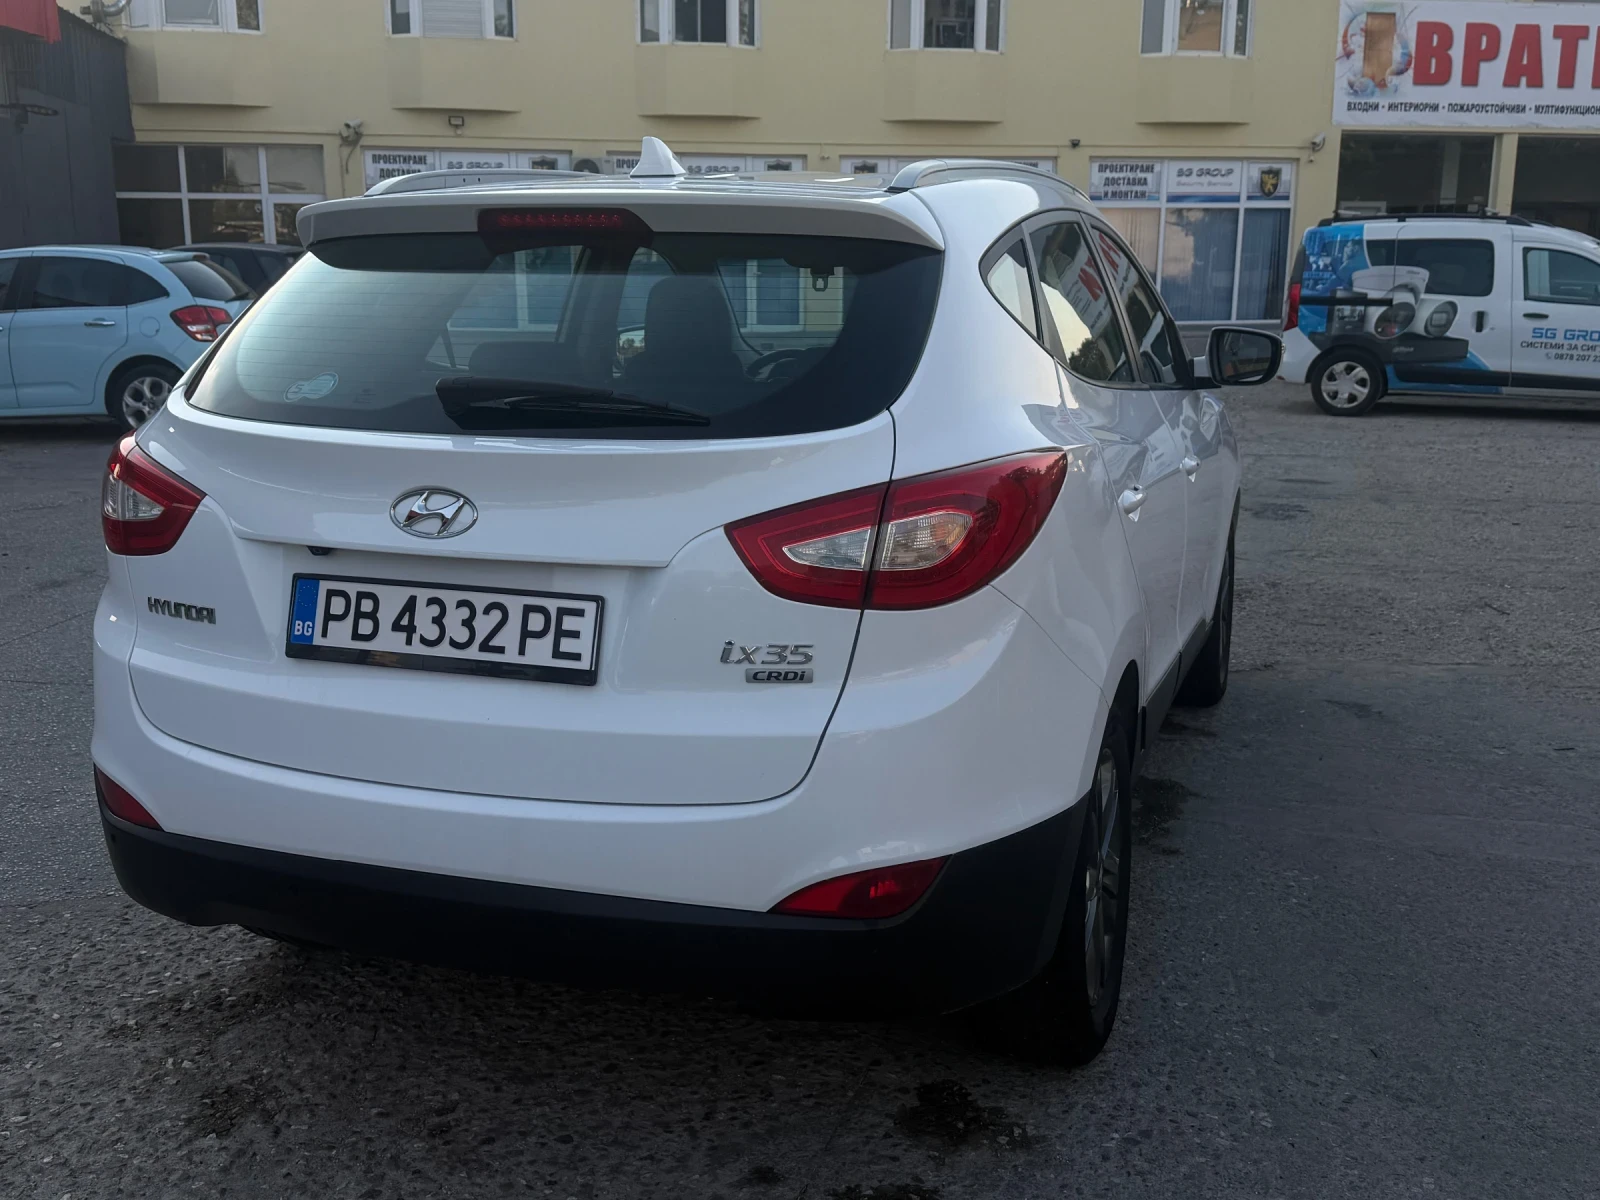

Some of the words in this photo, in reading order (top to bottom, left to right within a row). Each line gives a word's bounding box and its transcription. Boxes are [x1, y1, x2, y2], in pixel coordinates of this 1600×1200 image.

[1413, 21, 1600, 89] ВРАТ
[1346, 101, 1380, 112] ВХОДНИ
[1387, 101, 1440, 113] ИНТЕРИОРНИ
[1447, 102, 1526, 114] ПОЖАРОУСТОЙЧИВИ
[371, 153, 427, 165] ПРОЕКТИРАНЕ
[1097, 163, 1155, 174] ПРОЕКТИРАНЕ
[1196, 168, 1234, 177] GROUP
[1103, 177, 1148, 187] ДОСТАВКА
[1103, 190, 1109, 199] И
[1110, 190, 1147, 200] МОНТАЖ
[1532, 327, 1557, 340] SG
[1563, 329, 1600, 342] GRO
[1520, 341, 1564, 350] СИСТЕМИ
[1566, 343, 1579, 351] ЗА
[1580, 344, 1600, 352] СИГ
[147, 596, 217, 625] HYUNDAI
[294, 619, 313, 636] BG
[321, 588, 380, 642] PB
[391, 594, 510, 656] 4332
[517, 603, 586, 662] PE
[720, 639, 815, 665] ix35
[752, 670, 806, 682] CRDi
